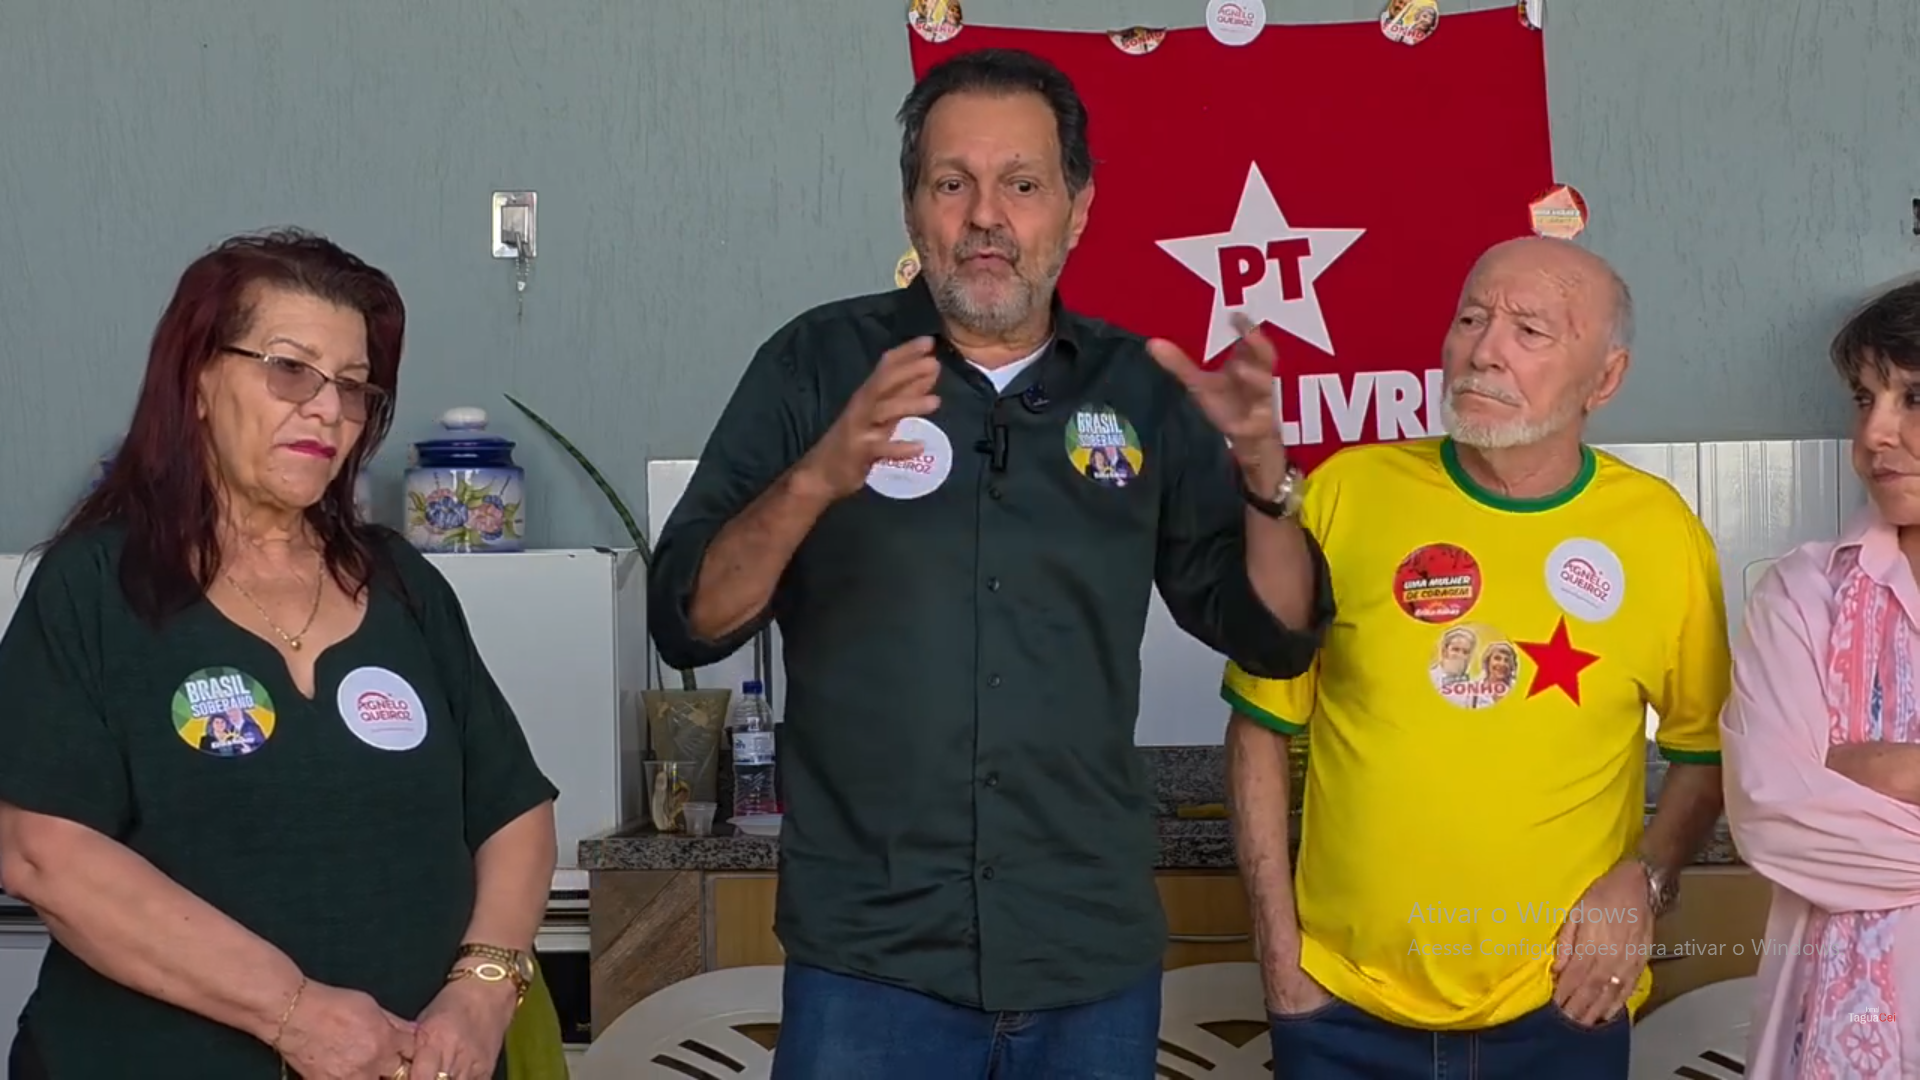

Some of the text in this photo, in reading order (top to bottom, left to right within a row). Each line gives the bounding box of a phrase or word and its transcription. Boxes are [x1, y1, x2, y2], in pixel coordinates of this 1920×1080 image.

[1217, 237, 1312, 306] PT
[1077, 412, 1123, 433] BRASIL
[1428, 575, 1471, 587] MULHER
[1560, 570, 1608, 602] QUEIROZ
[1563, 558, 1611, 592] AGNELO
[185, 674, 251, 703] BRASIL
[1442, 682, 1507, 695] SONHO
[190, 695, 255, 717] SOBERANO
[358, 692, 408, 711] AGNELO
